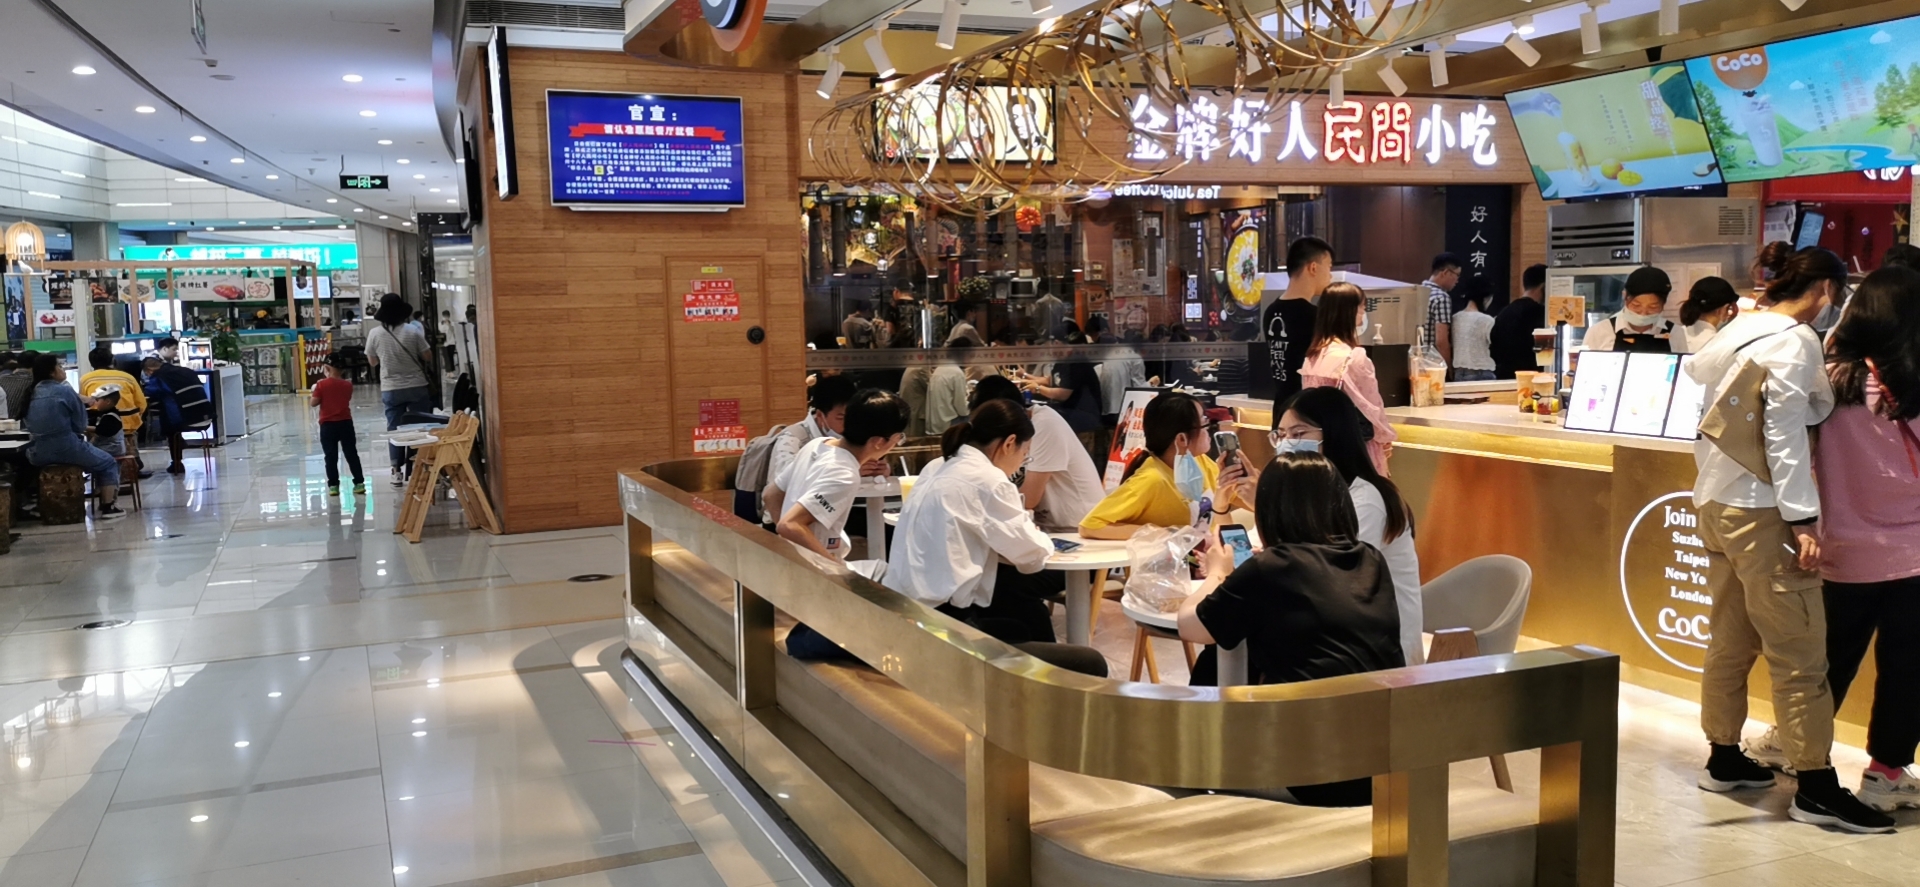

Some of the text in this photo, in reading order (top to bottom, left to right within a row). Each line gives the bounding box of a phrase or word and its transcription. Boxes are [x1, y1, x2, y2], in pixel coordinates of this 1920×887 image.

[1716, 53, 1763, 71] CoCo
[1470, 205, 1488, 277] 好人有
[1663, 505, 1697, 528] Join
[1674, 549, 1710, 568] Taipei
[1664, 566, 1707, 586] New Yo
[1670, 586, 1713, 606] London
[1657, 607, 1713, 641] CoC
